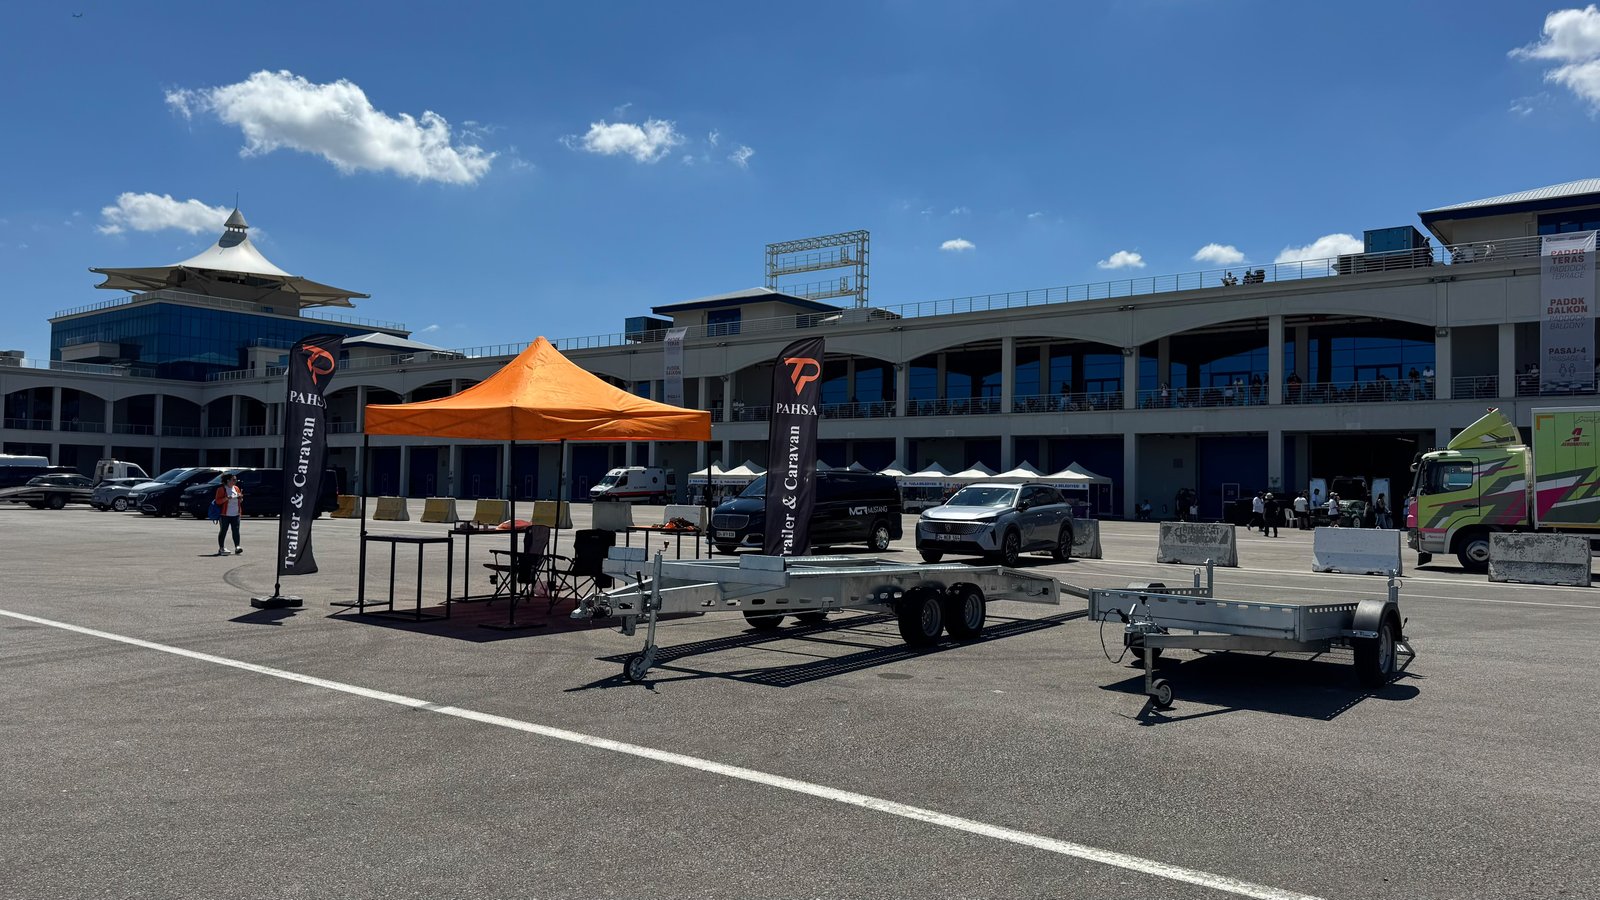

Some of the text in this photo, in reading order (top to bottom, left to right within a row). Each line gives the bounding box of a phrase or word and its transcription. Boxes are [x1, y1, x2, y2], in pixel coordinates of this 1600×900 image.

[1552, 256, 1584, 264] TERAS
[1550, 297, 1585, 306] PADOK
[1547, 305, 1588, 315] BALKON
[1548, 347, 1586, 355] PASAJ-4
[776, 402, 818, 416] PAHSA
[284, 417, 316, 569] Trailer & Caravan
[780, 425, 800, 557] railer & Caravan
